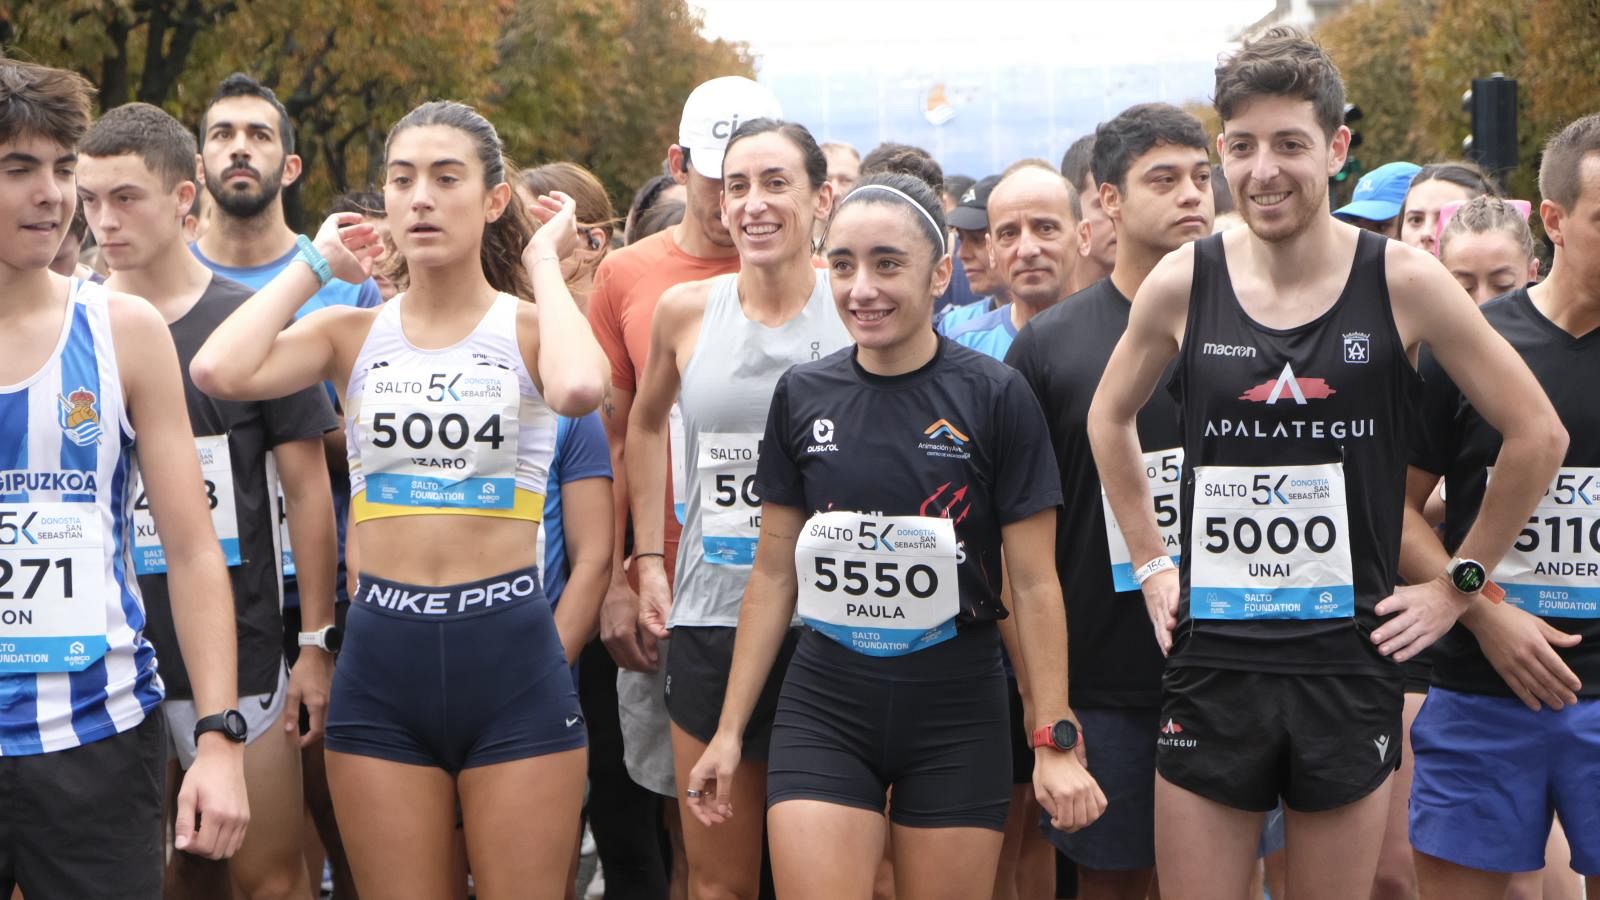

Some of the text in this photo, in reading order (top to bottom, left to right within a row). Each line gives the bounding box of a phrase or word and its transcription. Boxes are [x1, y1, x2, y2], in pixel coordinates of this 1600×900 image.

[1203, 343, 1256, 358] macron
[375, 373, 463, 402] SALTO 5K
[372, 412, 504, 450] 5004
[1204, 419, 1374, 439] APALATEGUI
[710, 448, 752, 461] SALTO
[411, 480, 438, 490] SALTO
[1291, 478, 1329, 487] DONOSTIA
[410, 490, 464, 500] FOUNDATION
[1204, 474, 1290, 505] SALTO 5K
[1288, 492, 1330, 500] SEBASTIAN
[1553, 474, 1594, 505] 5K
[41, 517, 81, 525] DONOSTIA
[810, 521, 895, 552] SALTO 5K
[1205, 515, 1336, 555] 5000
[894, 541, 937, 549] SEBASTIAN
[1249, 563, 1290, 577] UNAI
[1534, 561, 1598, 576] ANDER
[814, 556, 939, 599] 5550
[365, 575, 535, 614] NIKE PRO
[1244, 593, 1272, 602] SALTO
[1539, 590, 1569, 600] SALTO
[846, 603, 905, 619] PAULA
[1244, 603, 1301, 612] FOUNDATION
[1538, 600, 1597, 611] FOUNDATION
[851, 631, 880, 641] SALTO
[852, 640, 909, 650] FOUNDATION
